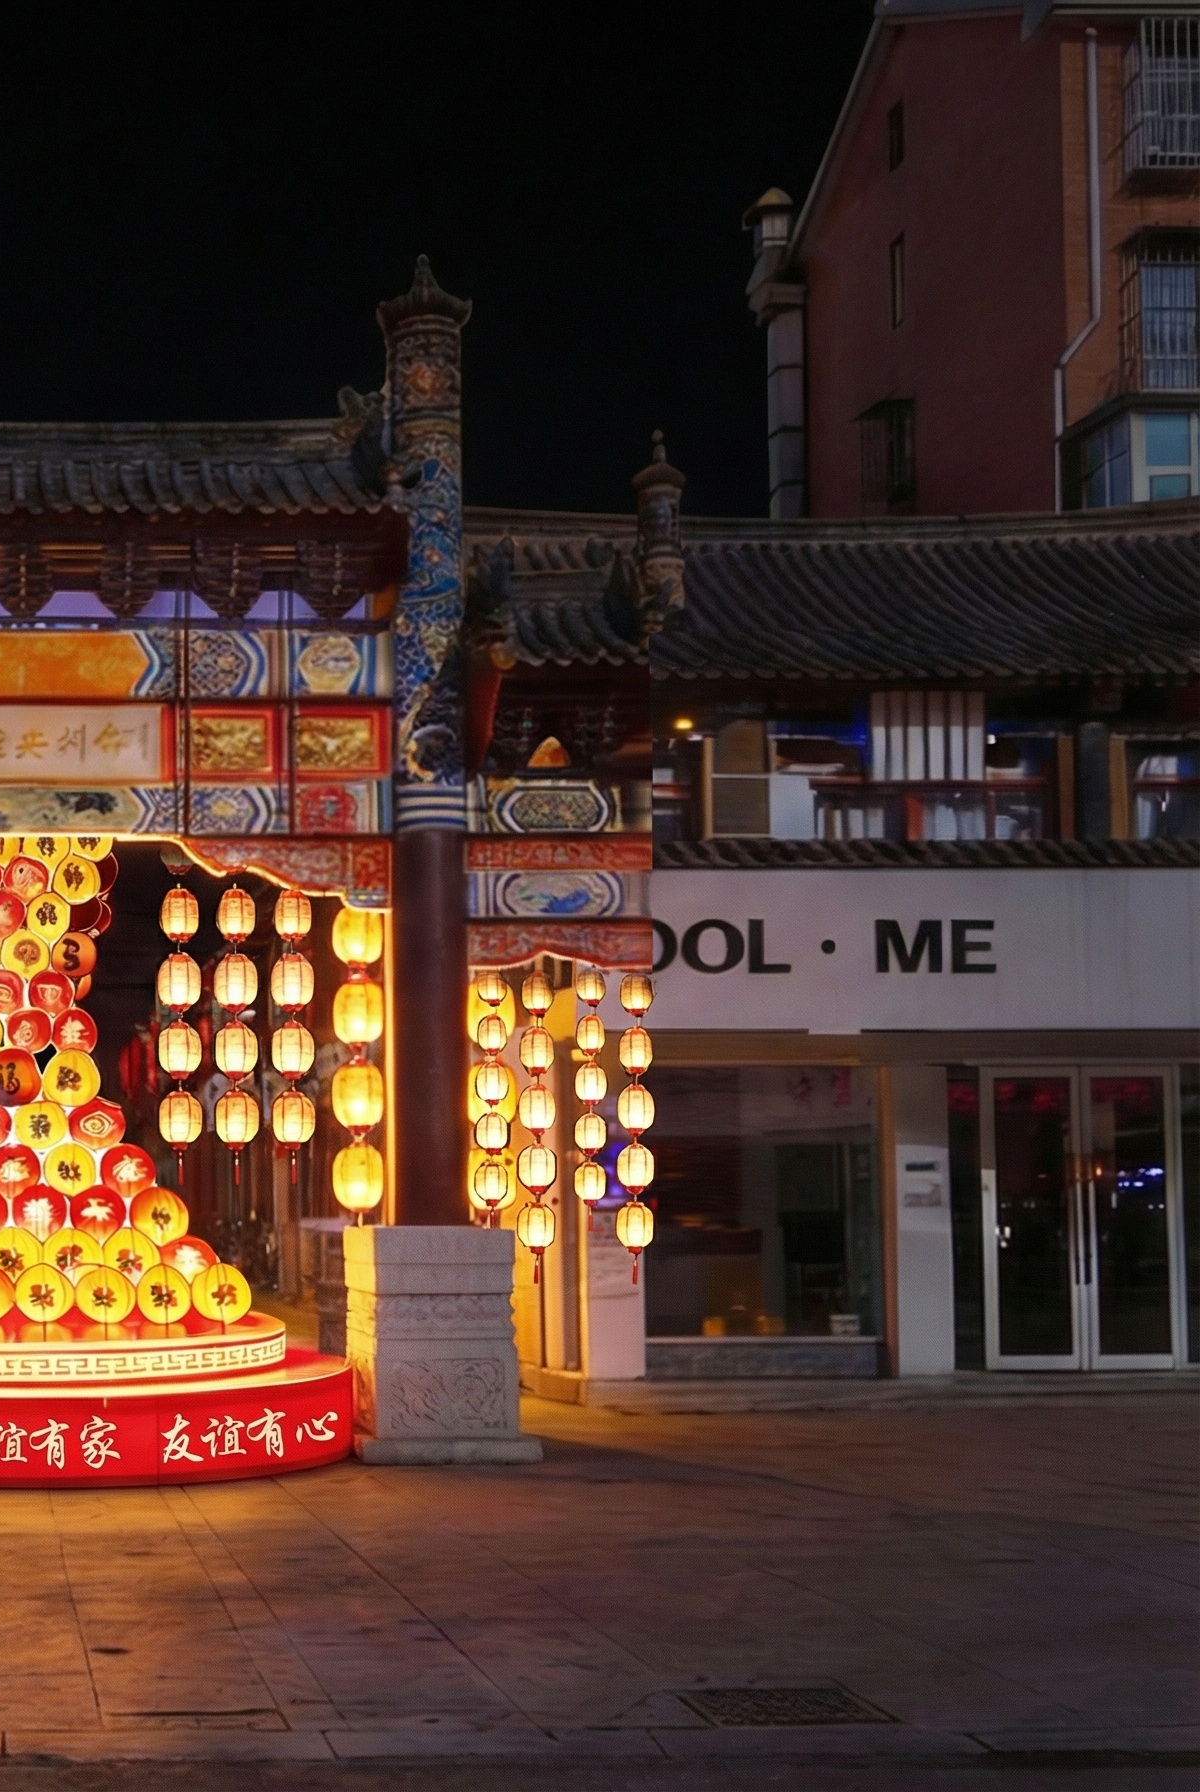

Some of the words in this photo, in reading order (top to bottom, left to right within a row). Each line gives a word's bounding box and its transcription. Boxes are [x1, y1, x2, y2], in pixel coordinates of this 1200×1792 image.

[874, 918, 997, 974] ME
[161, 1408, 338, 1464] 友谊有心
